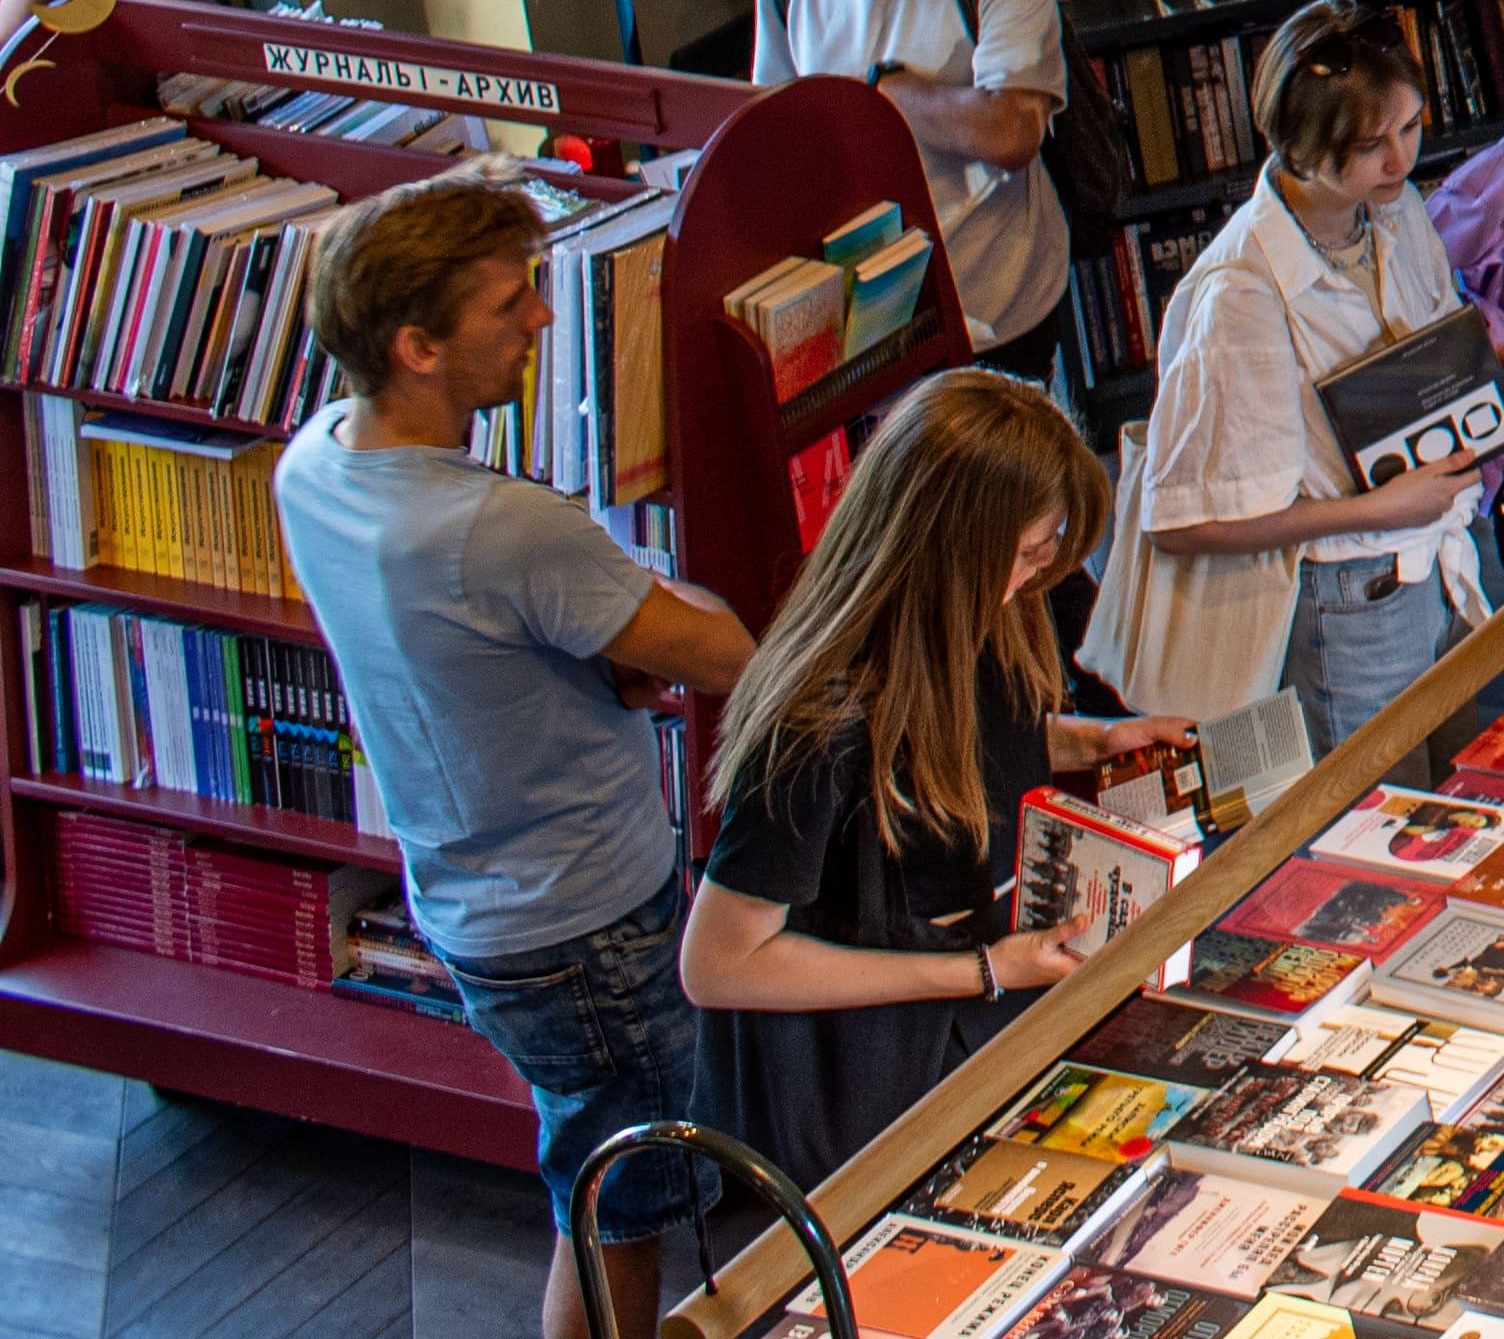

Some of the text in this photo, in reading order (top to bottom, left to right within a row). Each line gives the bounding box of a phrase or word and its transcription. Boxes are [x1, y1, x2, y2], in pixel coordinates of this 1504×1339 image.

[269, 45, 428, 92] ЖУРНАЛЫ
[457, 73, 555, 109] АРХИВ
[1237, 1224, 1270, 1252] МЕНЯ
[1259, 1245, 1285, 1267] ДЕД
[959, 1255, 1051, 1339] КОНЕЦ РЕЖИМА
